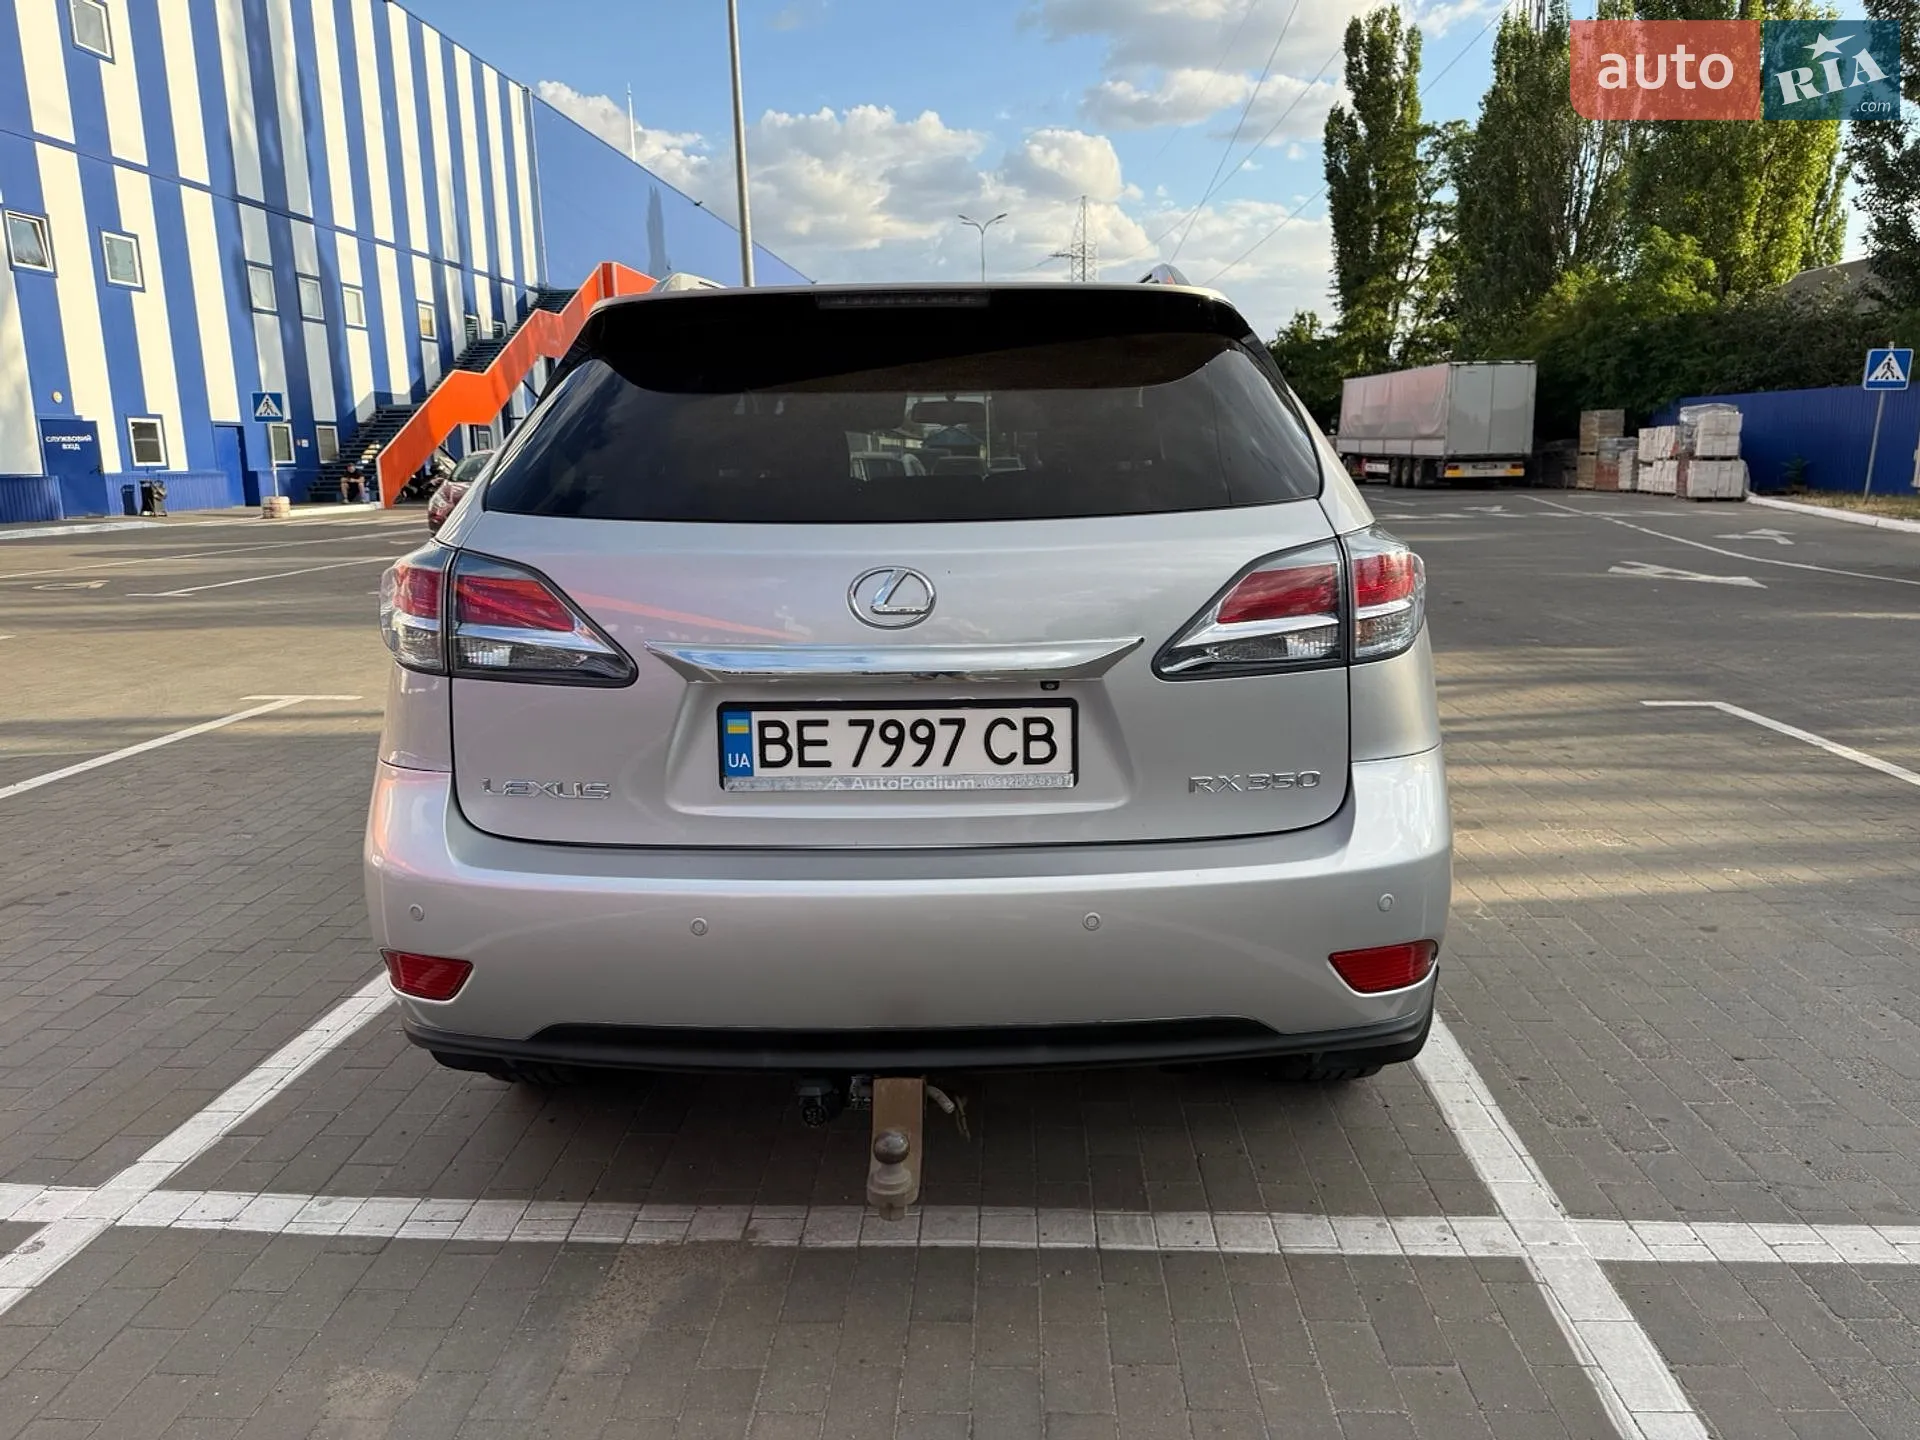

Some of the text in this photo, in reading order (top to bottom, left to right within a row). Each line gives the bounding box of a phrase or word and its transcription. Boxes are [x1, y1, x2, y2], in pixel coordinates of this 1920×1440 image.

[757, 716, 1058, 768] BE 7997 CB
[727, 753, 751, 768] UA
[481, 778, 611, 800] LEXUS
